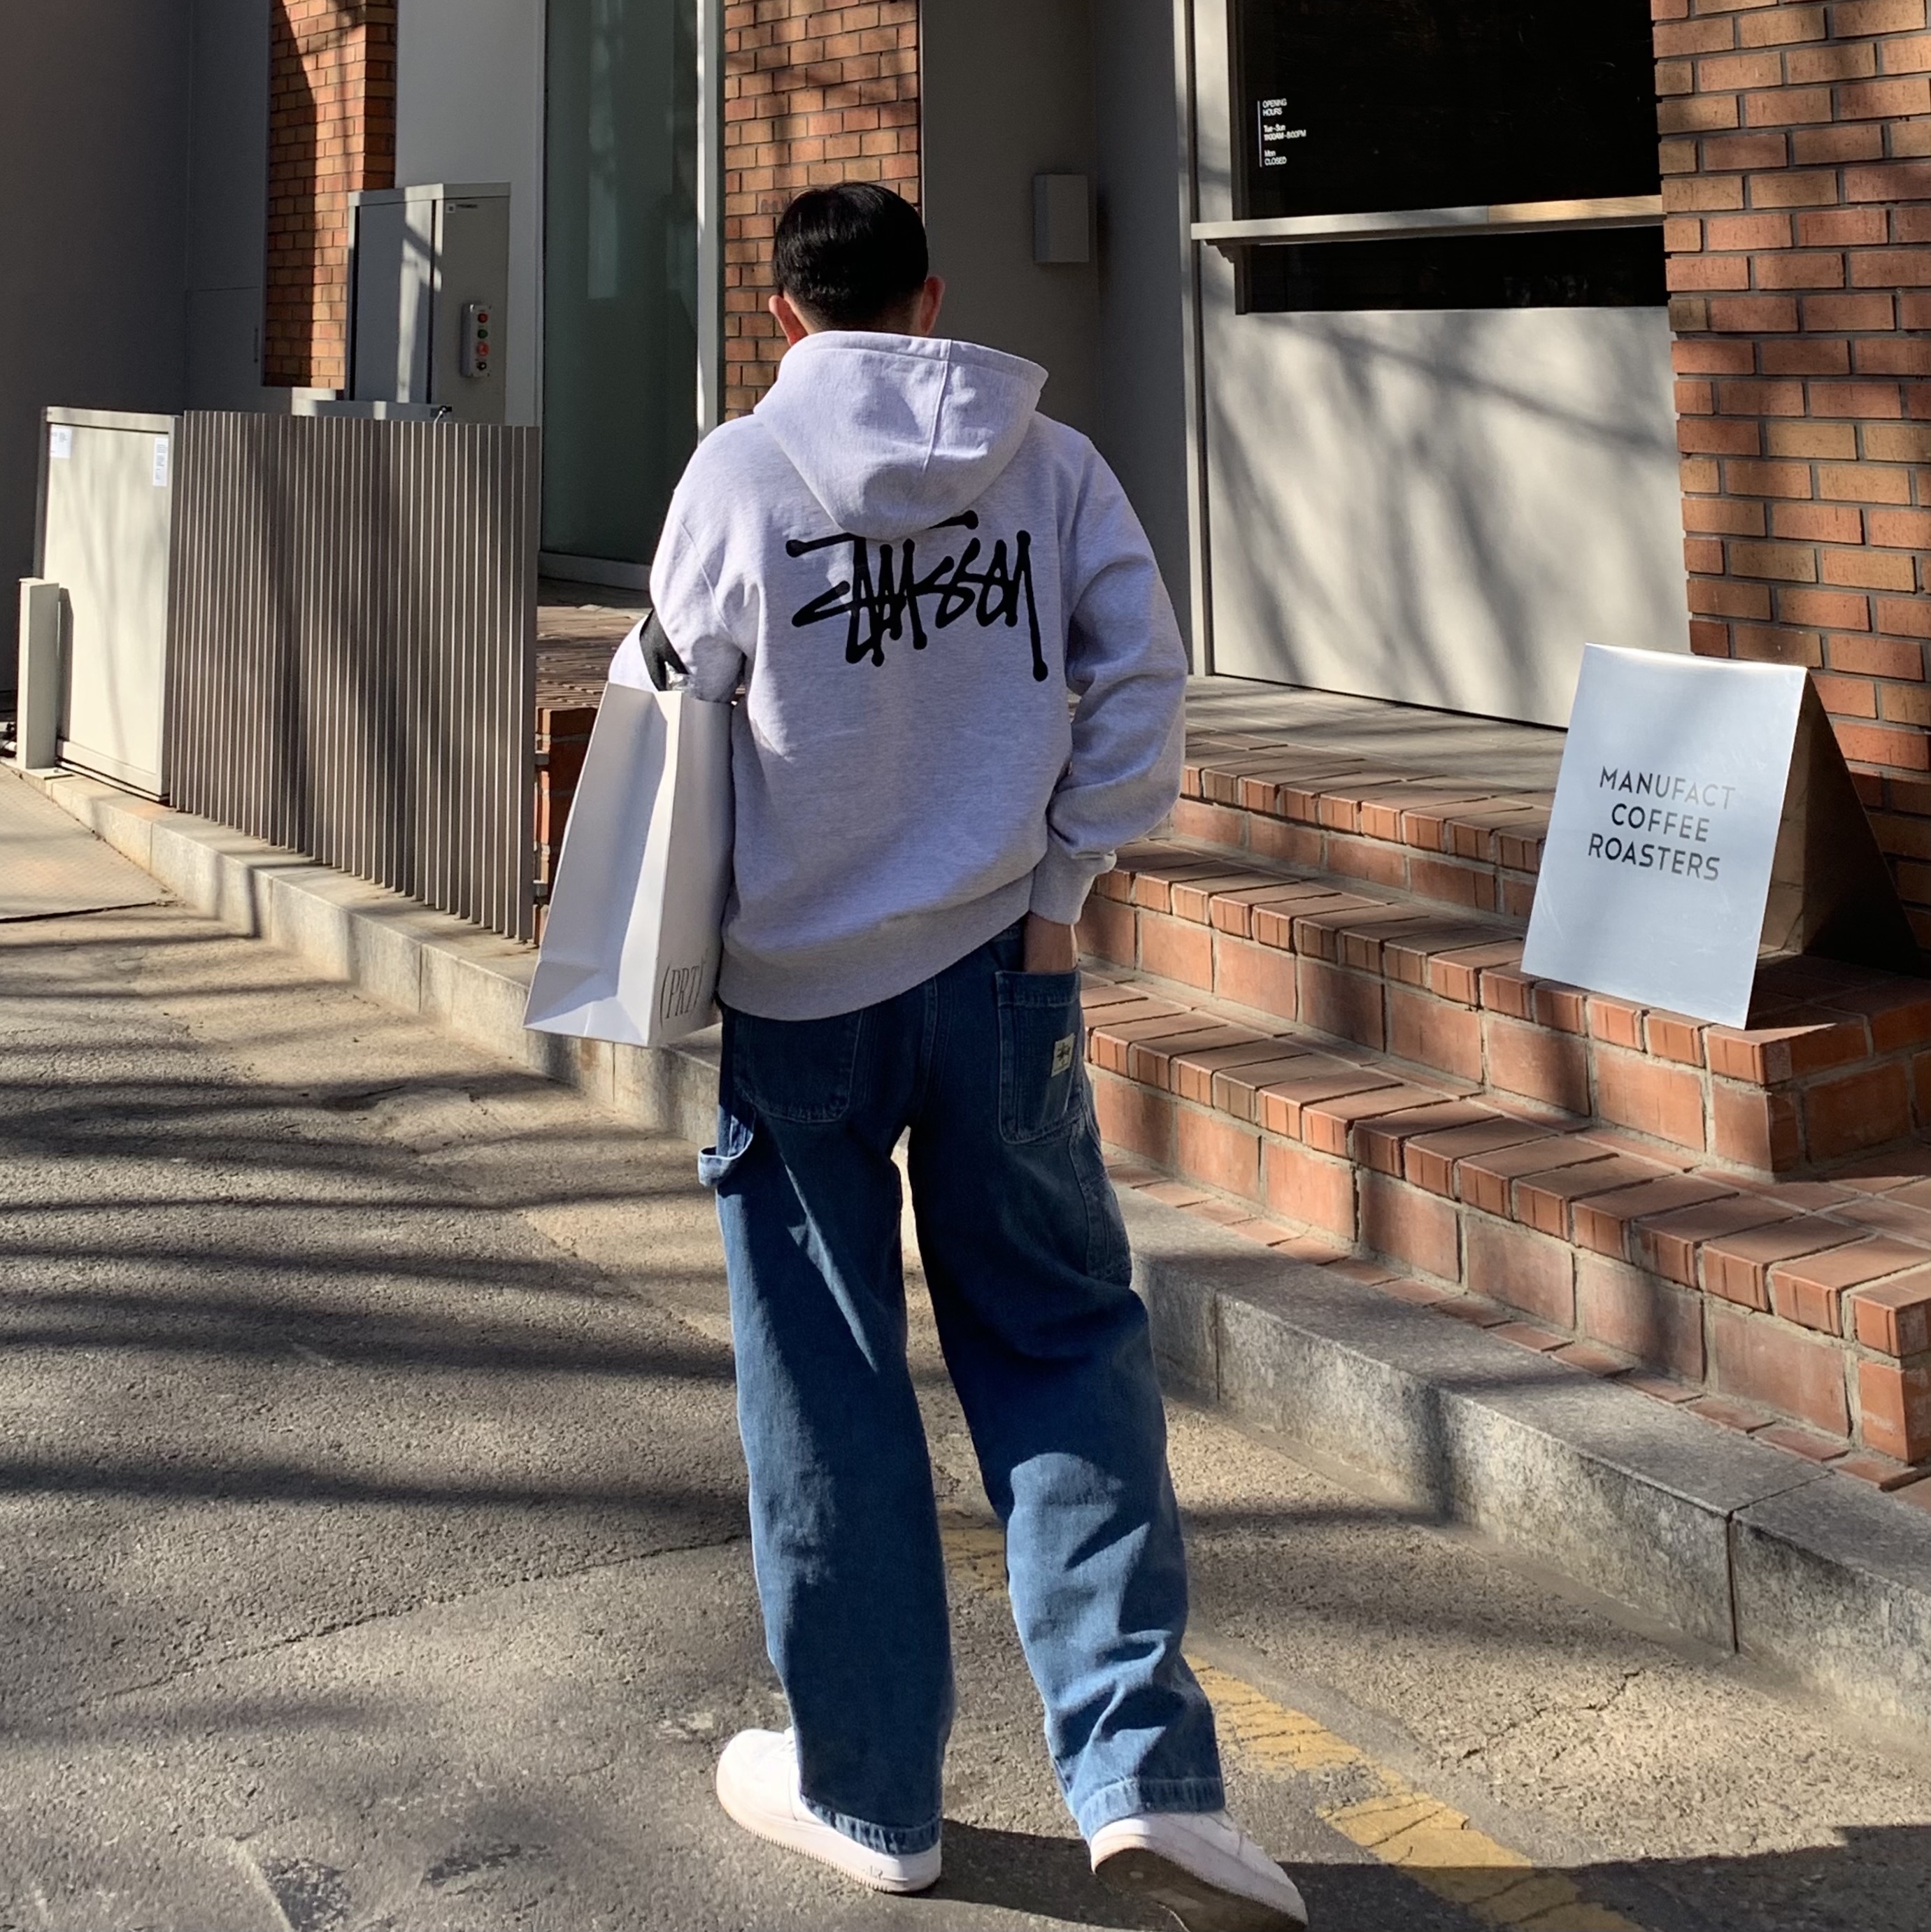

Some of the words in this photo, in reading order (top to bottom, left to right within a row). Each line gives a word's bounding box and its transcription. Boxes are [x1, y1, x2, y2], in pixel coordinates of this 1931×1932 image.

[1262, 98, 1287, 108] OPENING
[1262, 107, 1283, 116] HOURS
[1264, 156, 1287, 166] CLOSED
[1599, 766, 1736, 809] MANUFACT
[1611, 803, 1710, 843] COFFEE
[1588, 833, 1720, 881] ROASTERS
